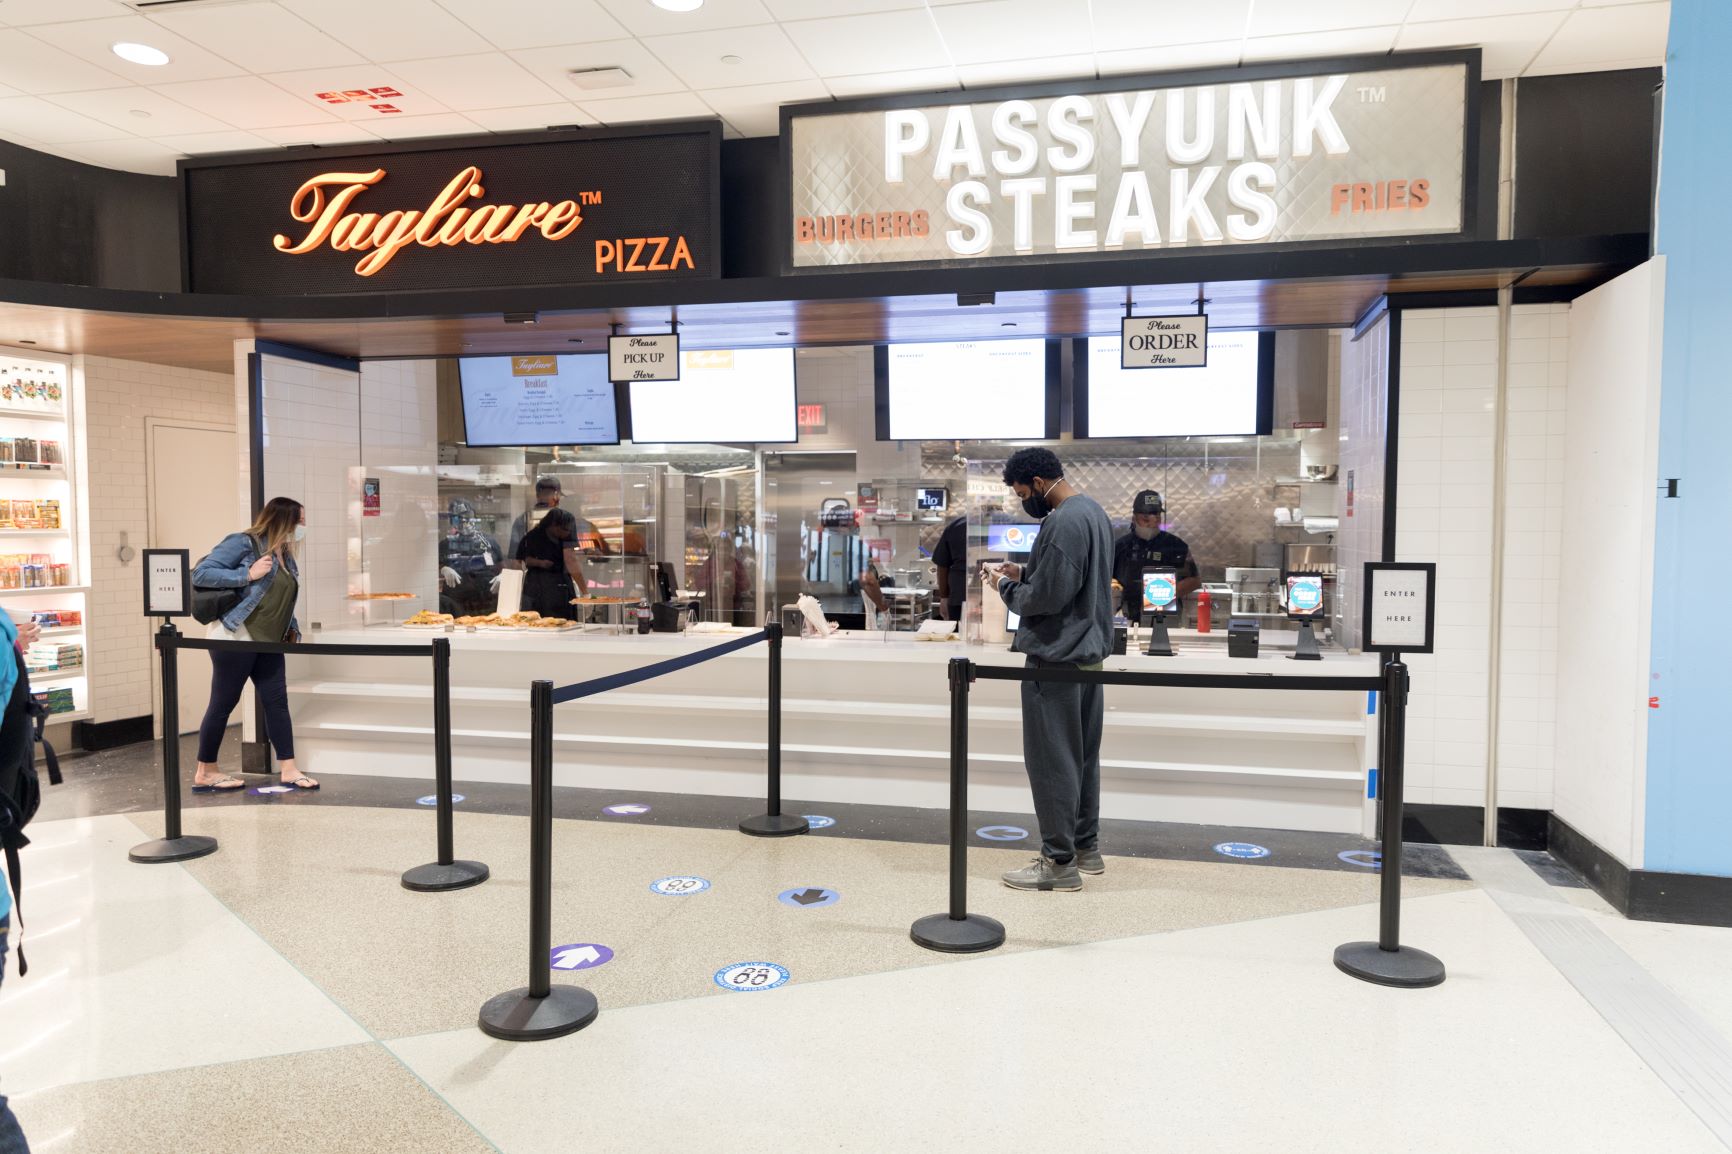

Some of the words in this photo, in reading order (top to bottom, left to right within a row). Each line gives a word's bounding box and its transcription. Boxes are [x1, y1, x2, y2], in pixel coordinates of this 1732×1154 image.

[884, 75, 1351, 183] PASSYUNK
[1356, 85, 1387, 104] TM
[1330, 178, 1432, 216] FRIES
[945, 161, 1279, 255] STEAKS
[273, 165, 584, 277] Tagliare
[579, 191, 603, 205] TM
[796, 208, 930, 244] BURGERS
[594, 236, 695, 273] PIZZA
[1147, 320, 1182, 331] Please
[629, 338, 658, 348] Please
[1129, 333, 1199, 351] ORDER
[623, 353, 648, 364] PICK
[649, 352, 665, 363] UP
[1150, 354, 1176, 364] Here
[633, 370, 655, 379] Here
[798, 405, 821, 425] EXIT
